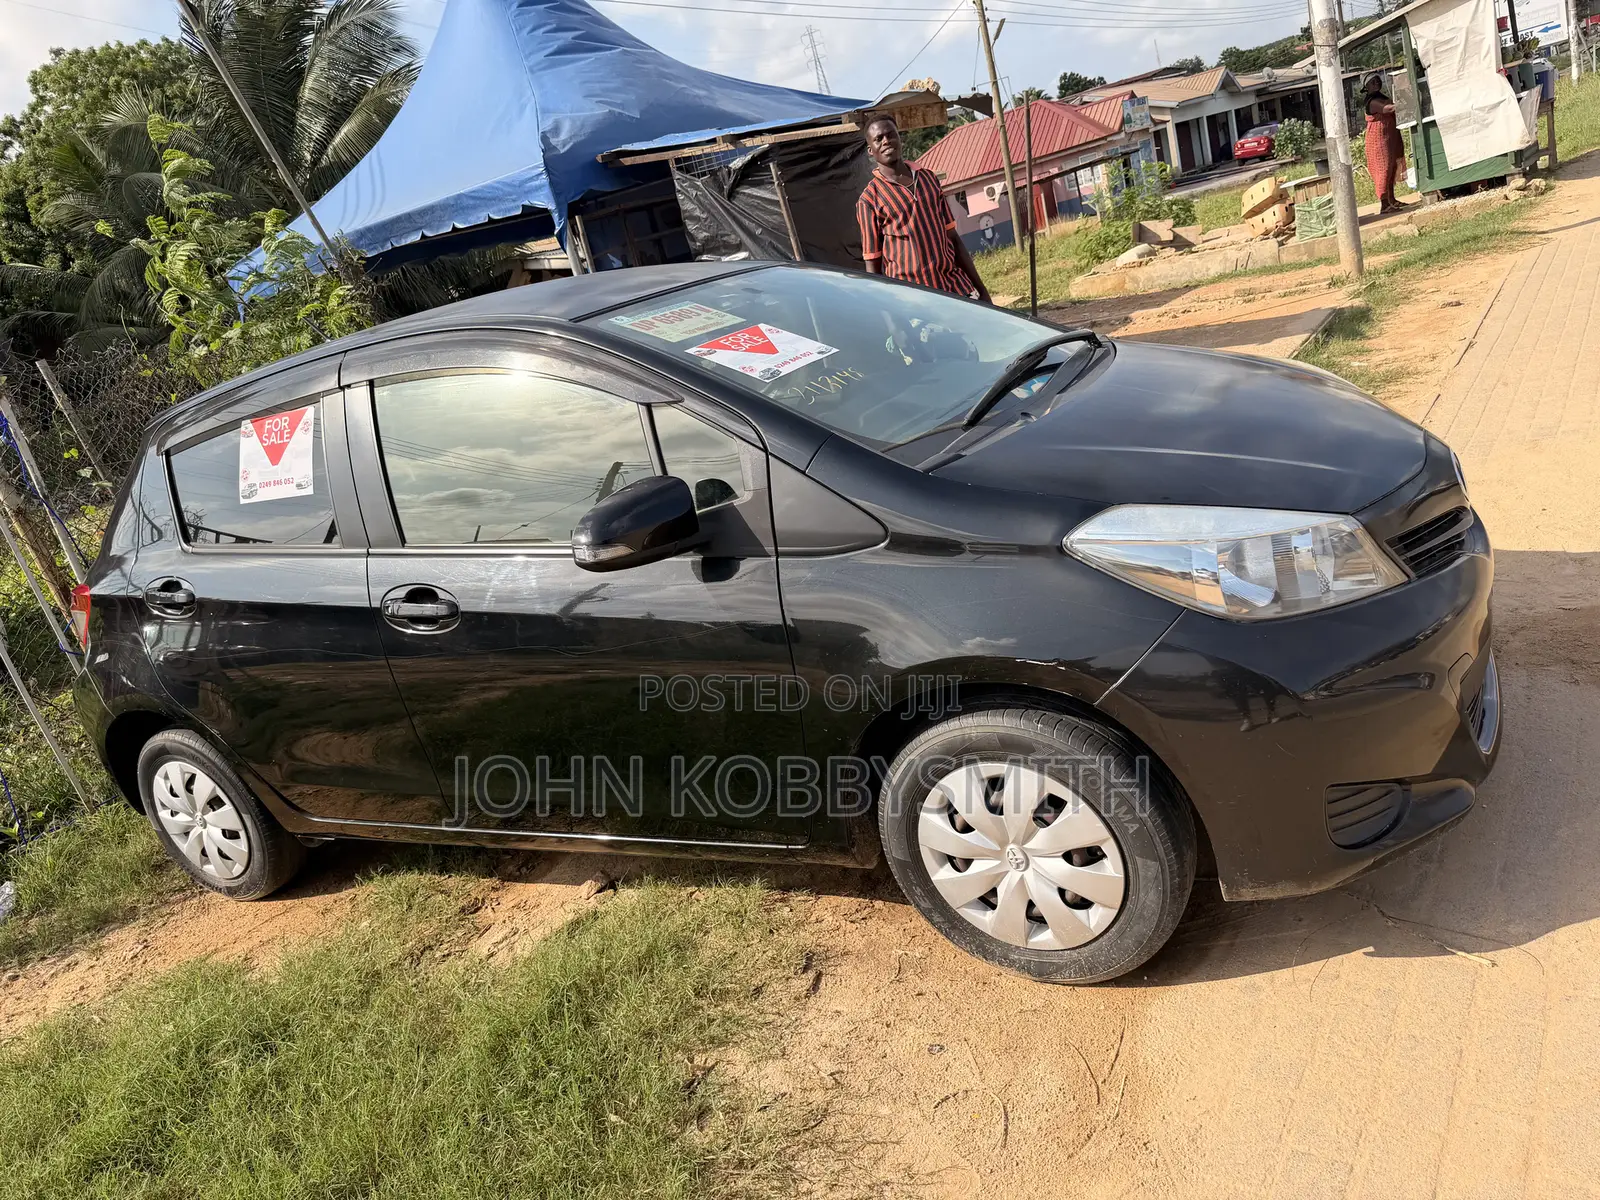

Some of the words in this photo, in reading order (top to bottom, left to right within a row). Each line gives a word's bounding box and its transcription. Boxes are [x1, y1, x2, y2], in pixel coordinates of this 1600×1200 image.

[720, 332, 752, 347] FOR
[731, 336, 769, 352] SALE
[265, 416, 289, 434] FOR
[262, 429, 291, 446] SALE
[259, 480, 272, 489] 0249
[272, 479, 283, 487] 846
[283, 477, 295, 486] 052
